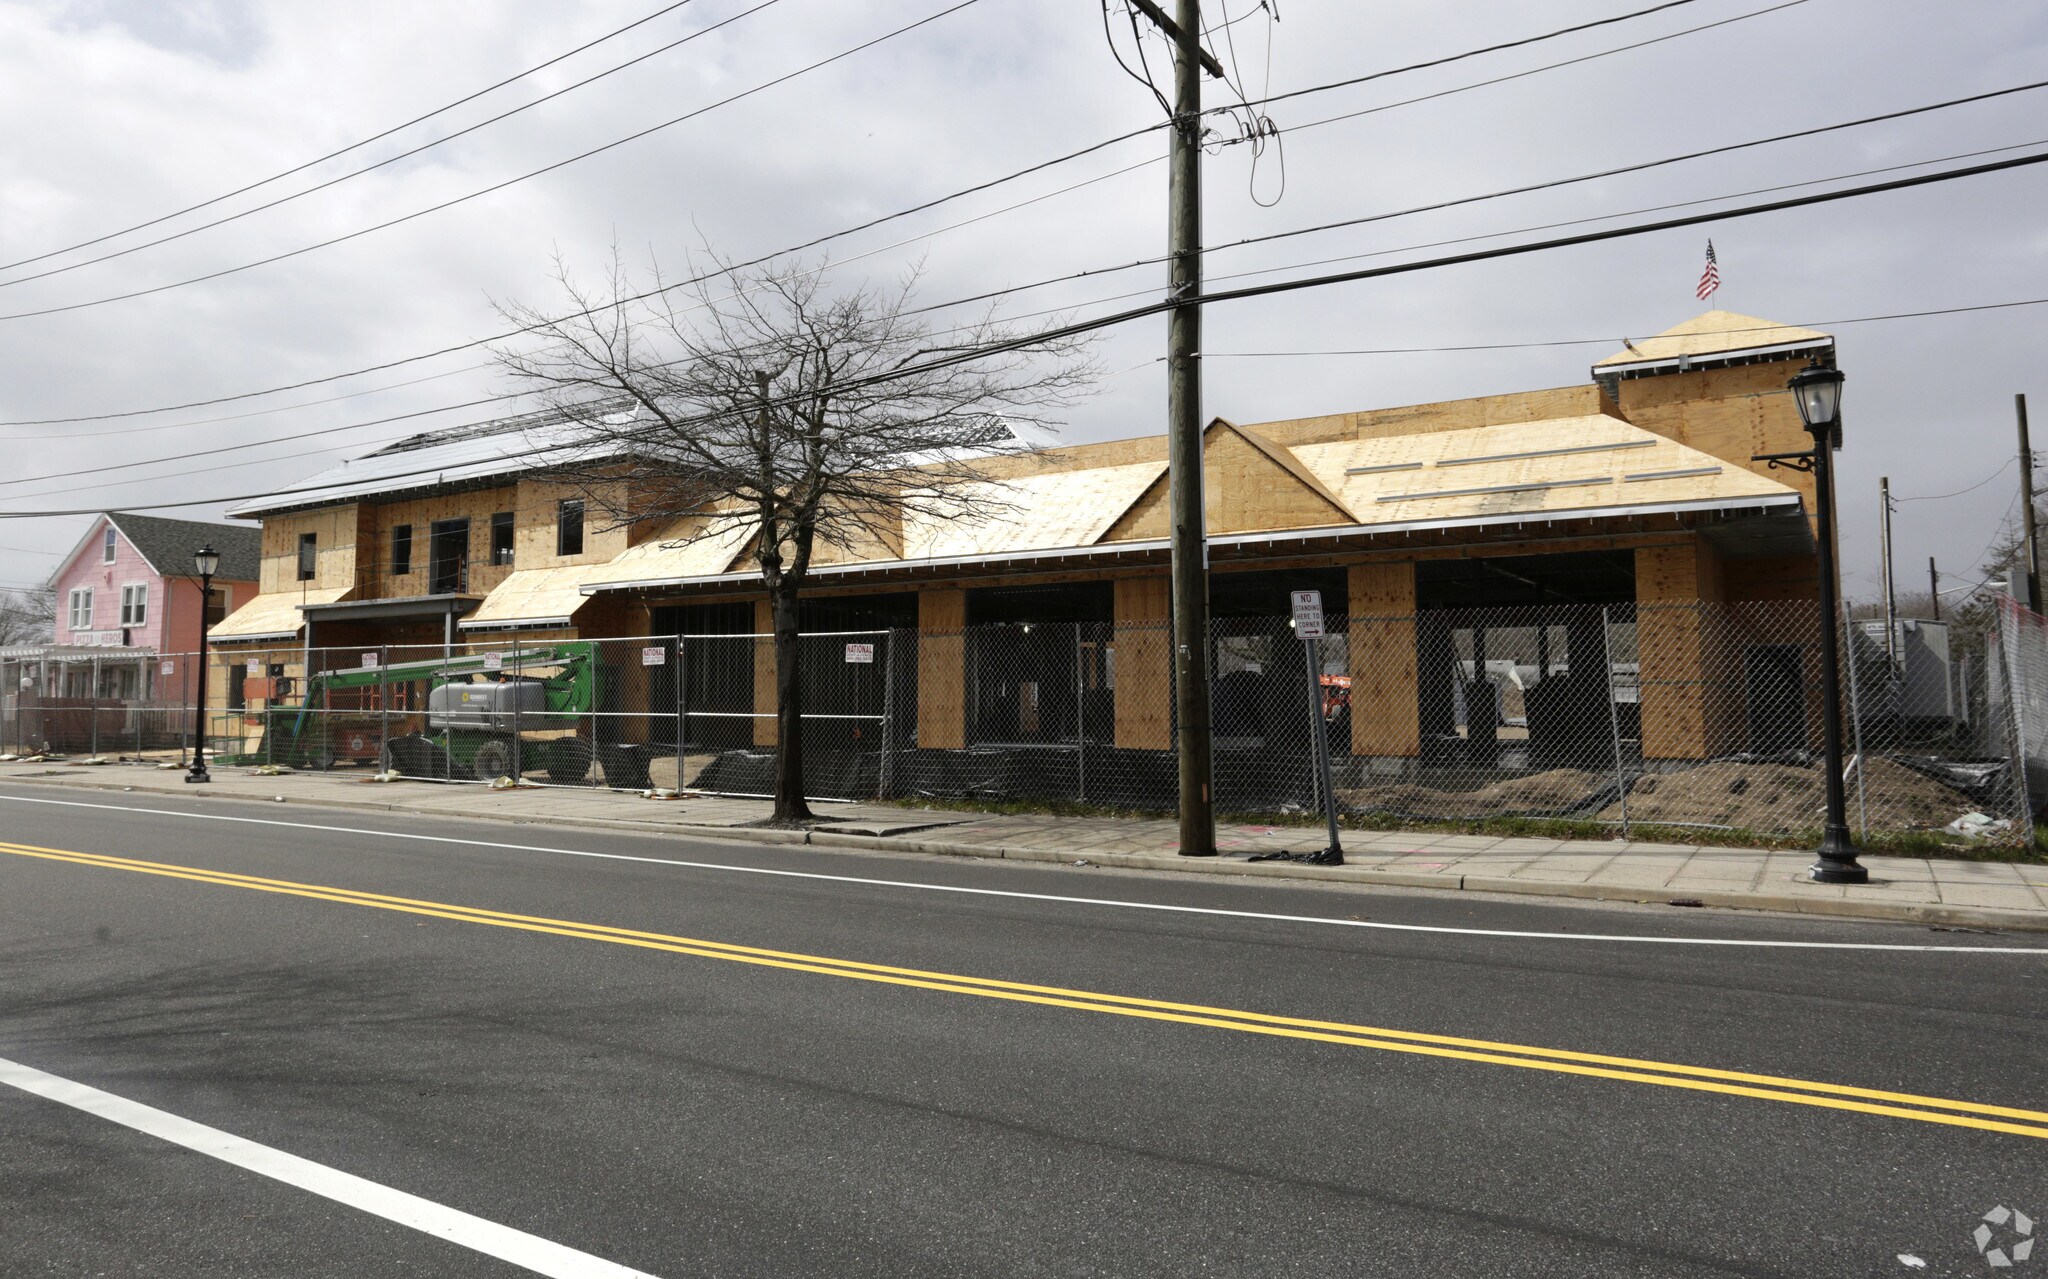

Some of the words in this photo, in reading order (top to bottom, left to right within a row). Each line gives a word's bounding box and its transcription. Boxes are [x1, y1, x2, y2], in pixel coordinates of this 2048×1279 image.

[1301, 594, 1311, 603] NO
[1313, 612, 1320, 620] TO
[76, 634, 94, 645] PIZZA
[101, 632, 122, 644] HEROS
[644, 648, 664, 656] NATIONAL
[847, 645, 872, 653] NATIONAL
